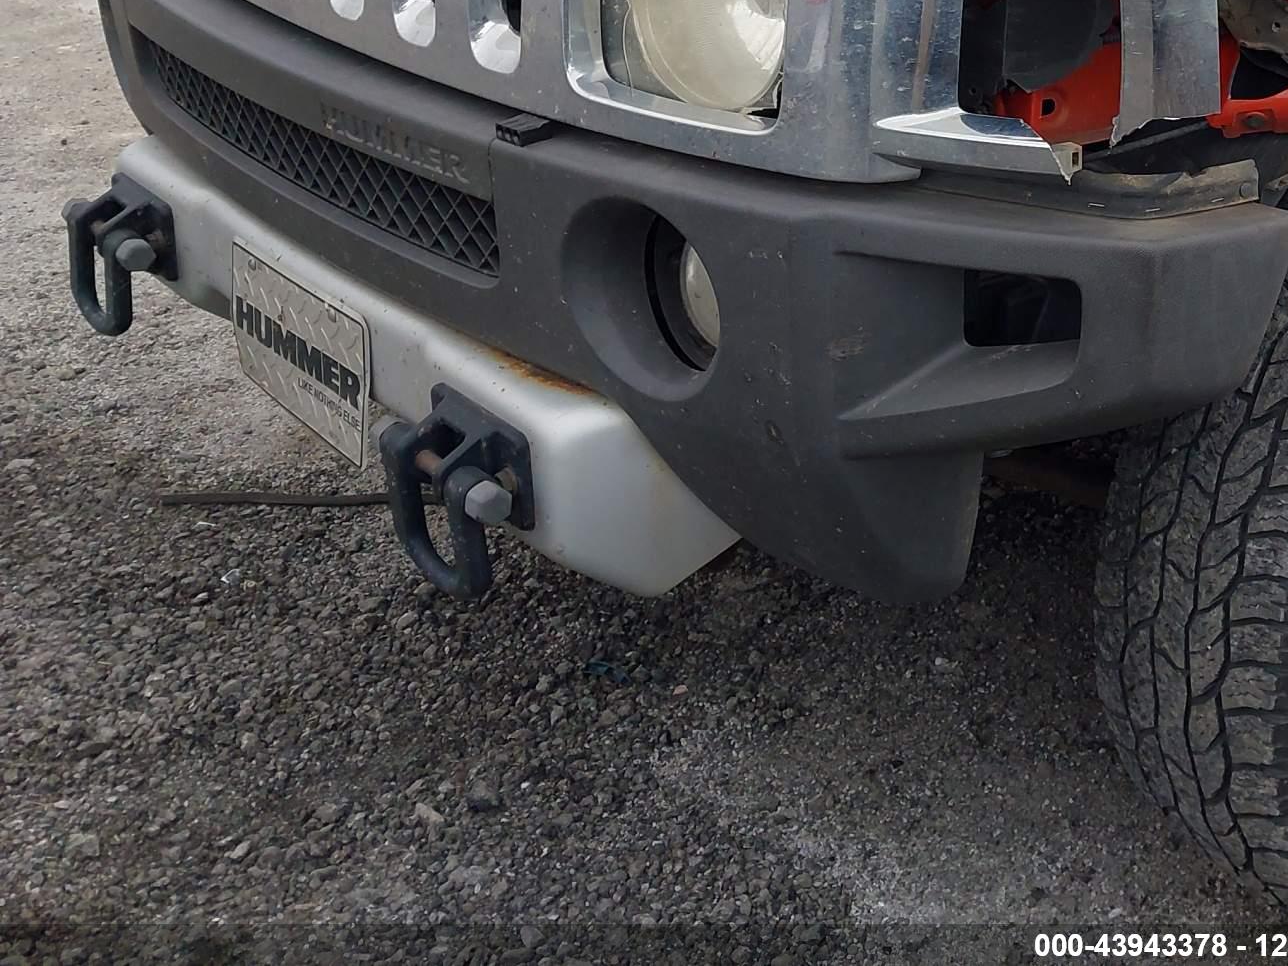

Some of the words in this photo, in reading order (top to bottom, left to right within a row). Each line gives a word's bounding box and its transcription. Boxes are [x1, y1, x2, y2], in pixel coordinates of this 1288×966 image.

[235, 294, 361, 412] HUMMER
[297, 378, 314, 395] LIKE
[343, 409, 361, 432] ELSE
